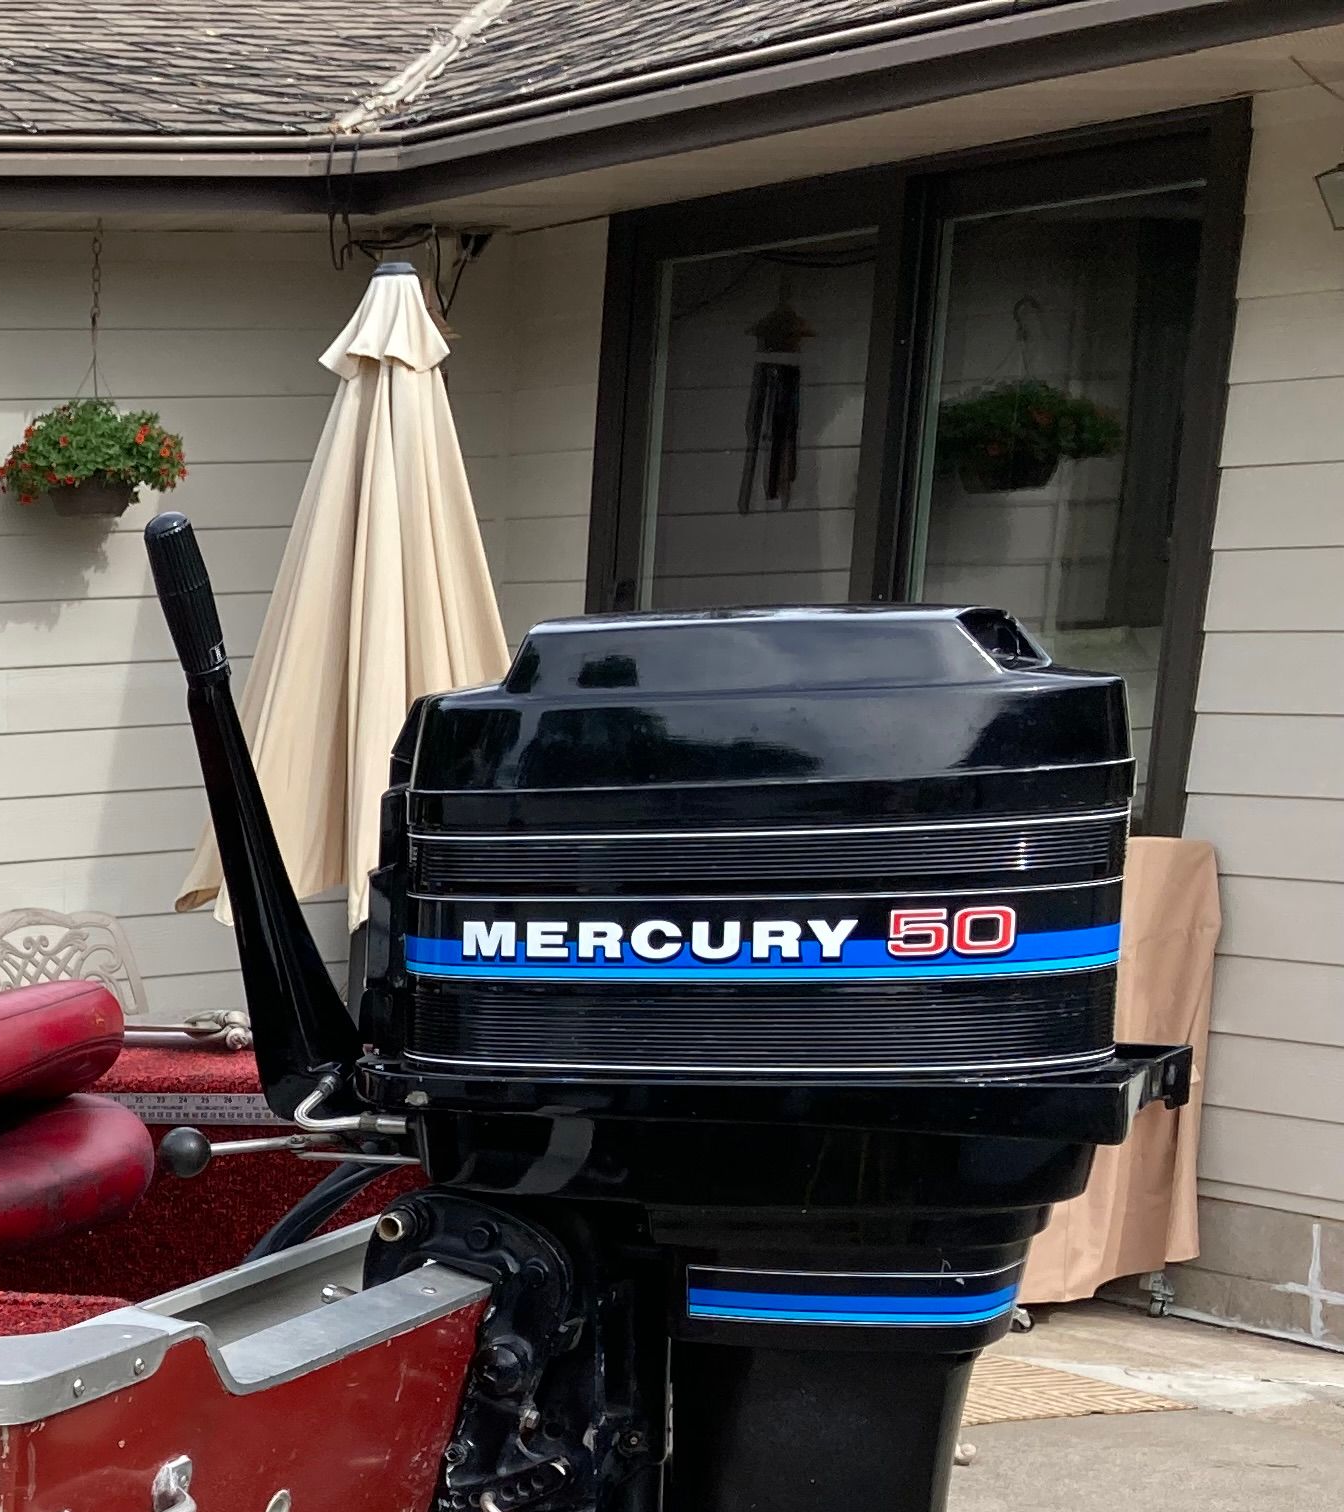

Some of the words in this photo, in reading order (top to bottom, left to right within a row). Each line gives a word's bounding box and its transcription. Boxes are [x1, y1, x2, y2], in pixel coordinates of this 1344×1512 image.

[461, 919, 859, 960] MERCURY
[887, 905, 1016, 956] 50
[135, 1095, 144, 1104] 22
[156, 1095, 166, 1104] 23
[178, 1095, 188, 1104] 24
[200, 1096, 210, 1104] 25
[223, 1096, 233, 1104] 26
[246, 1096, 256, 1104] 27
